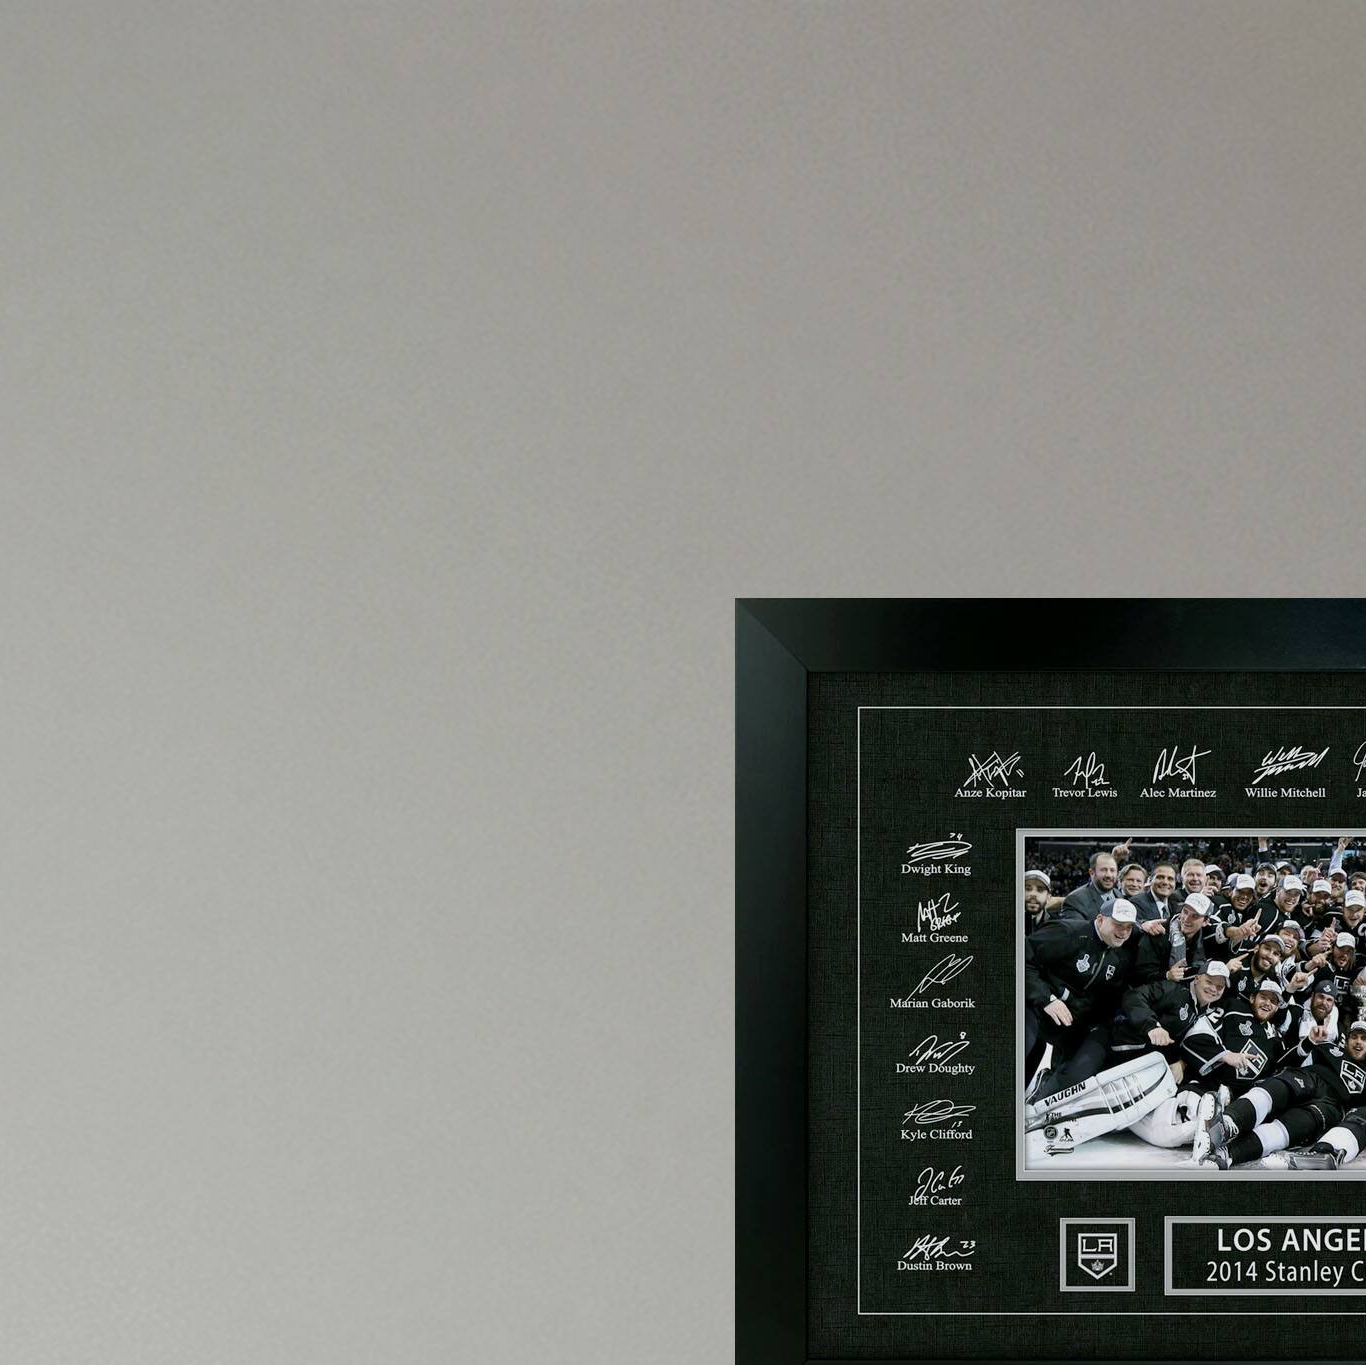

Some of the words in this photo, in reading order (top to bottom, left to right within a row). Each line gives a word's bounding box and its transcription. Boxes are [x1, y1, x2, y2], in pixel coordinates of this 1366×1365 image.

[955, 788, 980, 797] Anze
[986, 788, 1027, 799] Kopitar
[1052, 788, 1085, 797] Trevor
[1088, 788, 1117, 797] Lewis
[1140, 788, 1164, 797] Alec
[1168, 788, 1216, 797] Martinez
[1245, 788, 1277, 797] Willie
[1281, 788, 1325, 797] Mitchell
[901, 864, 941, 876] Dwight
[945, 864, 971, 876] King
[902, 933, 927, 942] Matt
[930, 933, 968, 942] Greene
[890, 999, 928, 1008] Marian
[932, 998, 975, 1008] Gaborik
[896, 1063, 925, 1072] Drew
[929, 1063, 975, 1075] Doughty
[1045, 1082, 1086, 1106] VAUGHN
[901, 1130, 926, 1141] Kyle
[930, 1130, 972, 1139] Clifford
[909, 1196, 928, 1205] Jeff
[930, 1196, 962, 1205] Carter
[1218, 1229, 1271, 1251] LOS
[897, 1261, 932, 1270] Dustin
[936, 1261, 972, 1270] Brown
[1207, 1261, 1257, 1281] 2014
[1266, 1260, 1344, 1287] Stanley
